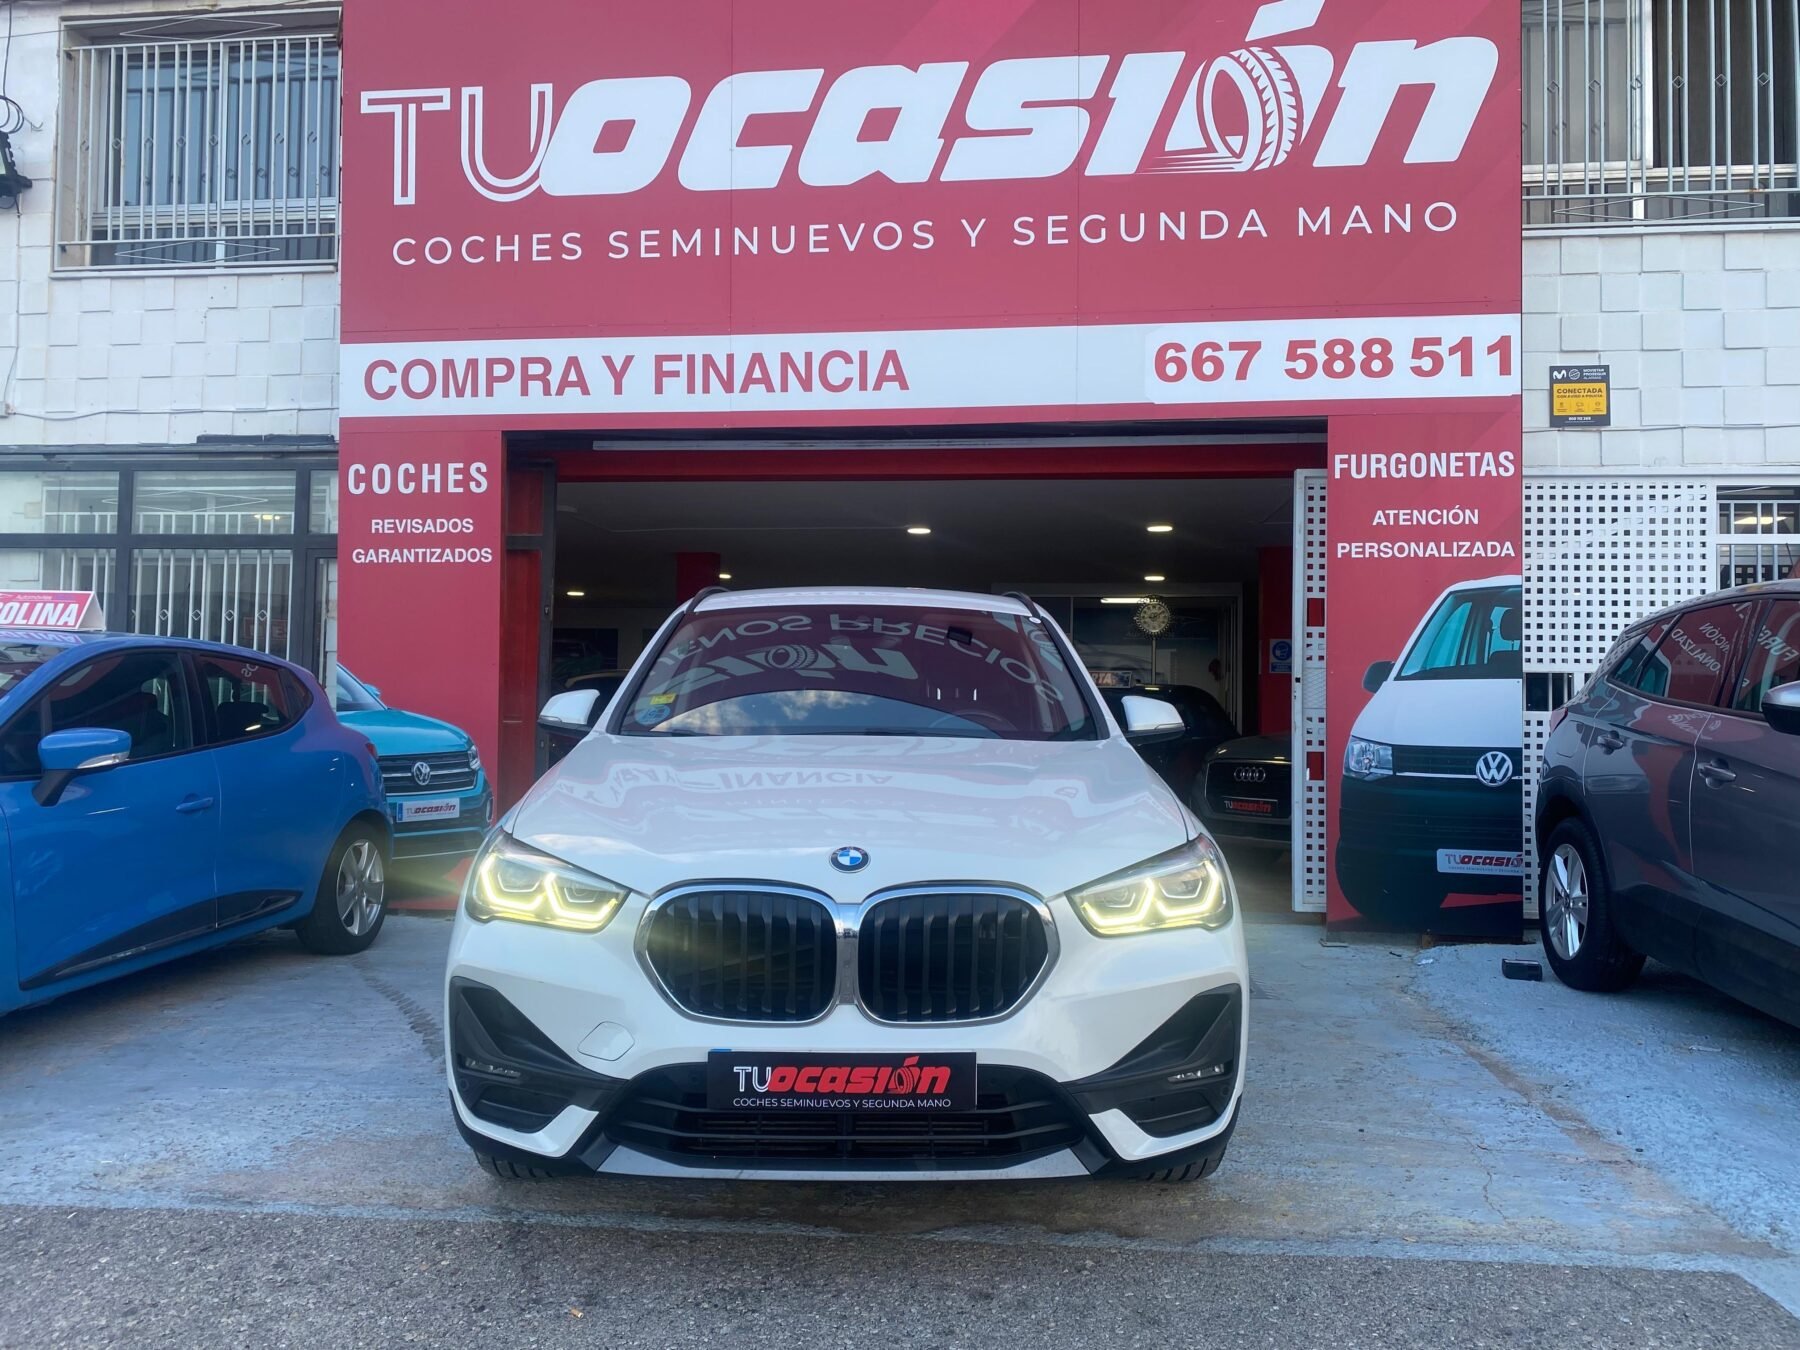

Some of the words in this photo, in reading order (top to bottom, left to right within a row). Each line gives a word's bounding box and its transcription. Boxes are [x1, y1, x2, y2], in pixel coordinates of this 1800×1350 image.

[393, 232, 582, 265] COCHES
[608, 221, 935, 259] SEMINUEVOS
[960, 219, 986, 248] Y
[1013, 208, 1268, 246] SEGUNDA
[1298, 201, 1458, 237] MANO
[1154, 341, 1262, 383] 667
[1284, 337, 1393, 380] 588
[1410, 335, 1512, 378] 511
[363, 356, 590, 400] COMPRA
[602, 355, 635, 395] Y
[653, 349, 909, 394] FINANCIA
[1333, 451, 1516, 479] FURGONETAS
[347, 461, 489, 495] COCHES
[371, 518, 475, 534] REVISADOS
[1372, 504, 1480, 526] ATENCIÓN
[352, 547, 493, 564] GARANTIZADOS
[1336, 541, 1516, 559] PERSONALIZADA
[0, 601, 79, 626] OLINA
[733, 1098, 778, 1107] COCHES
[780, 1098, 851, 1108] SEMINUEVOS
[853, 1099, 860, 1107] Y
[862, 1099, 915, 1108] SEGUNDA
[917, 1099, 952, 1108] MANO
